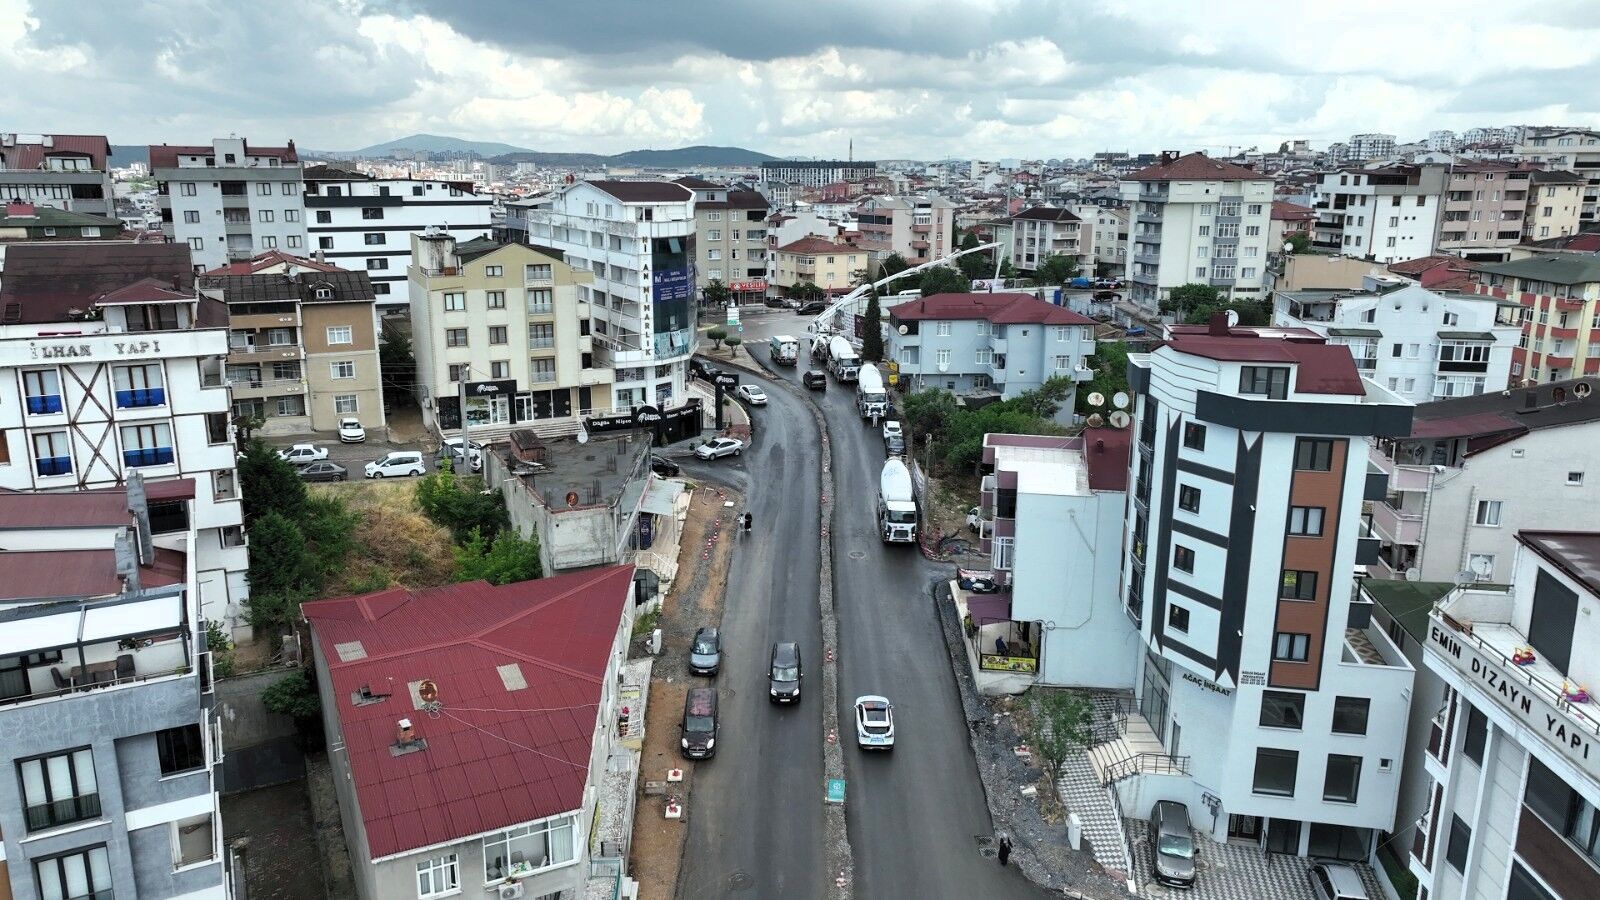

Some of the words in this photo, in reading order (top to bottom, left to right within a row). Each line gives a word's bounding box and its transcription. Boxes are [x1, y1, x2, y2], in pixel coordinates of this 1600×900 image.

[643, 286, 651, 356] MİMARLIK
[30, 342, 92, 359] İLHAN
[114, 340, 161, 355] YAPI
[1183, 674, 1203, 686] AĞAÇ
[1204, 680, 1231, 696] İNŞAAT
[1431, 626, 1462, 659] EMİN
[1471, 657, 1532, 715] DİZAYN
[1546, 713, 1589, 760] YAPI
